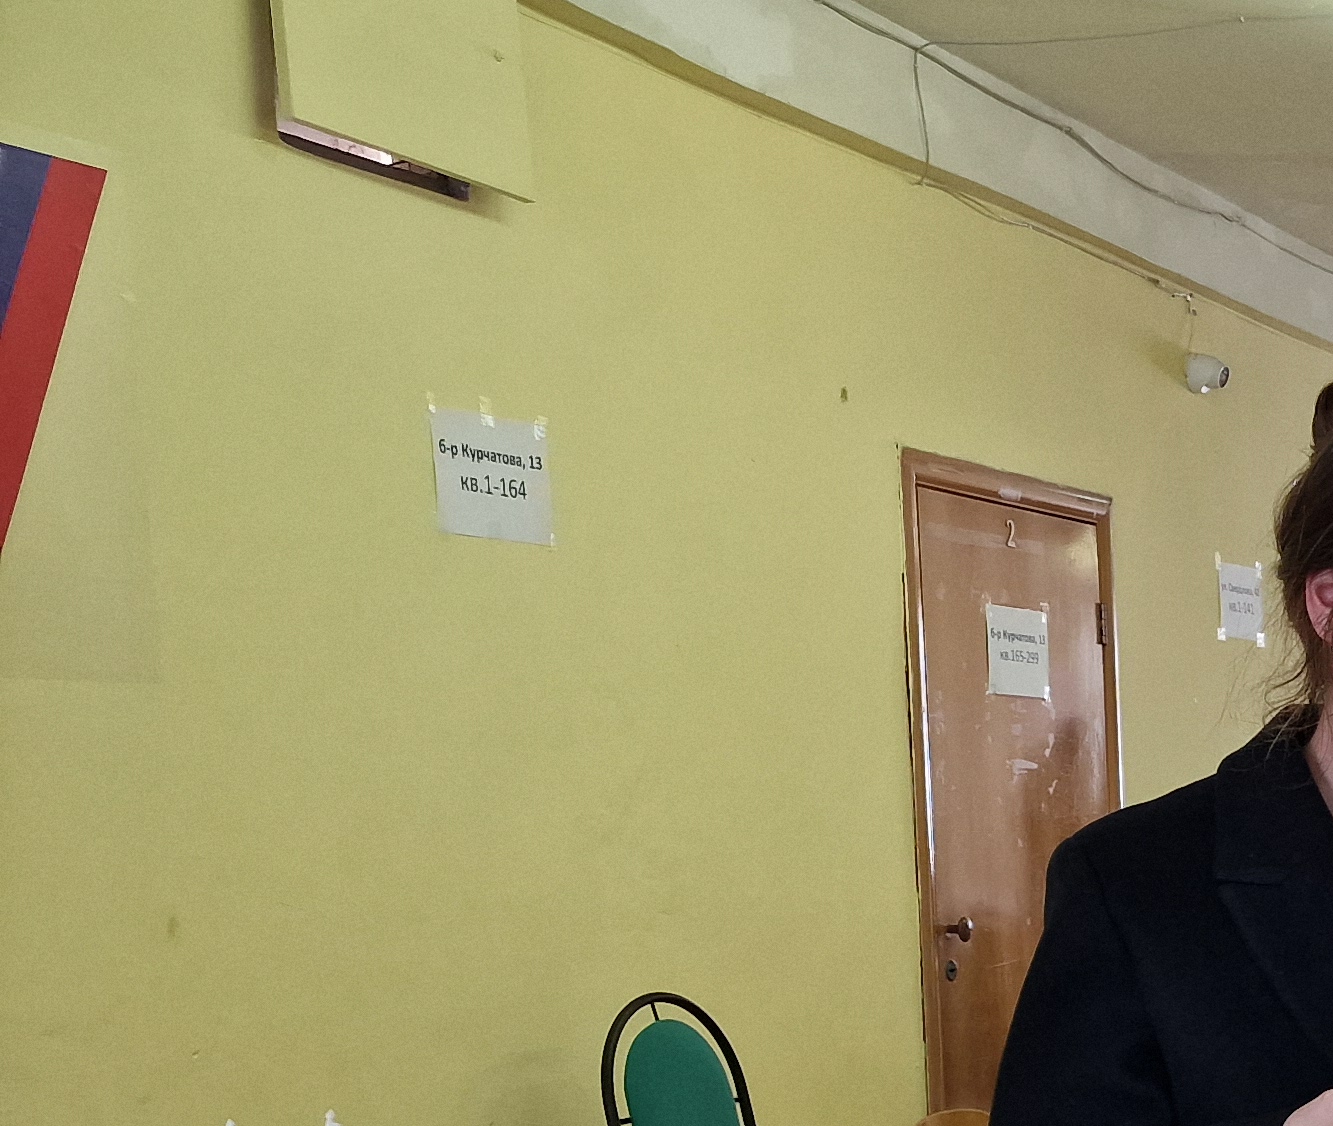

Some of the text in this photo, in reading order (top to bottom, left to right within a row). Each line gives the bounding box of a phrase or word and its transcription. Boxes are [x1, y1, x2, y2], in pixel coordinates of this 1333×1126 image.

[439, 439, 543, 471] б-р Курчатова, 13
[460, 475, 527, 500] кв.1-164
[1005, 519, 1017, 548] 2
